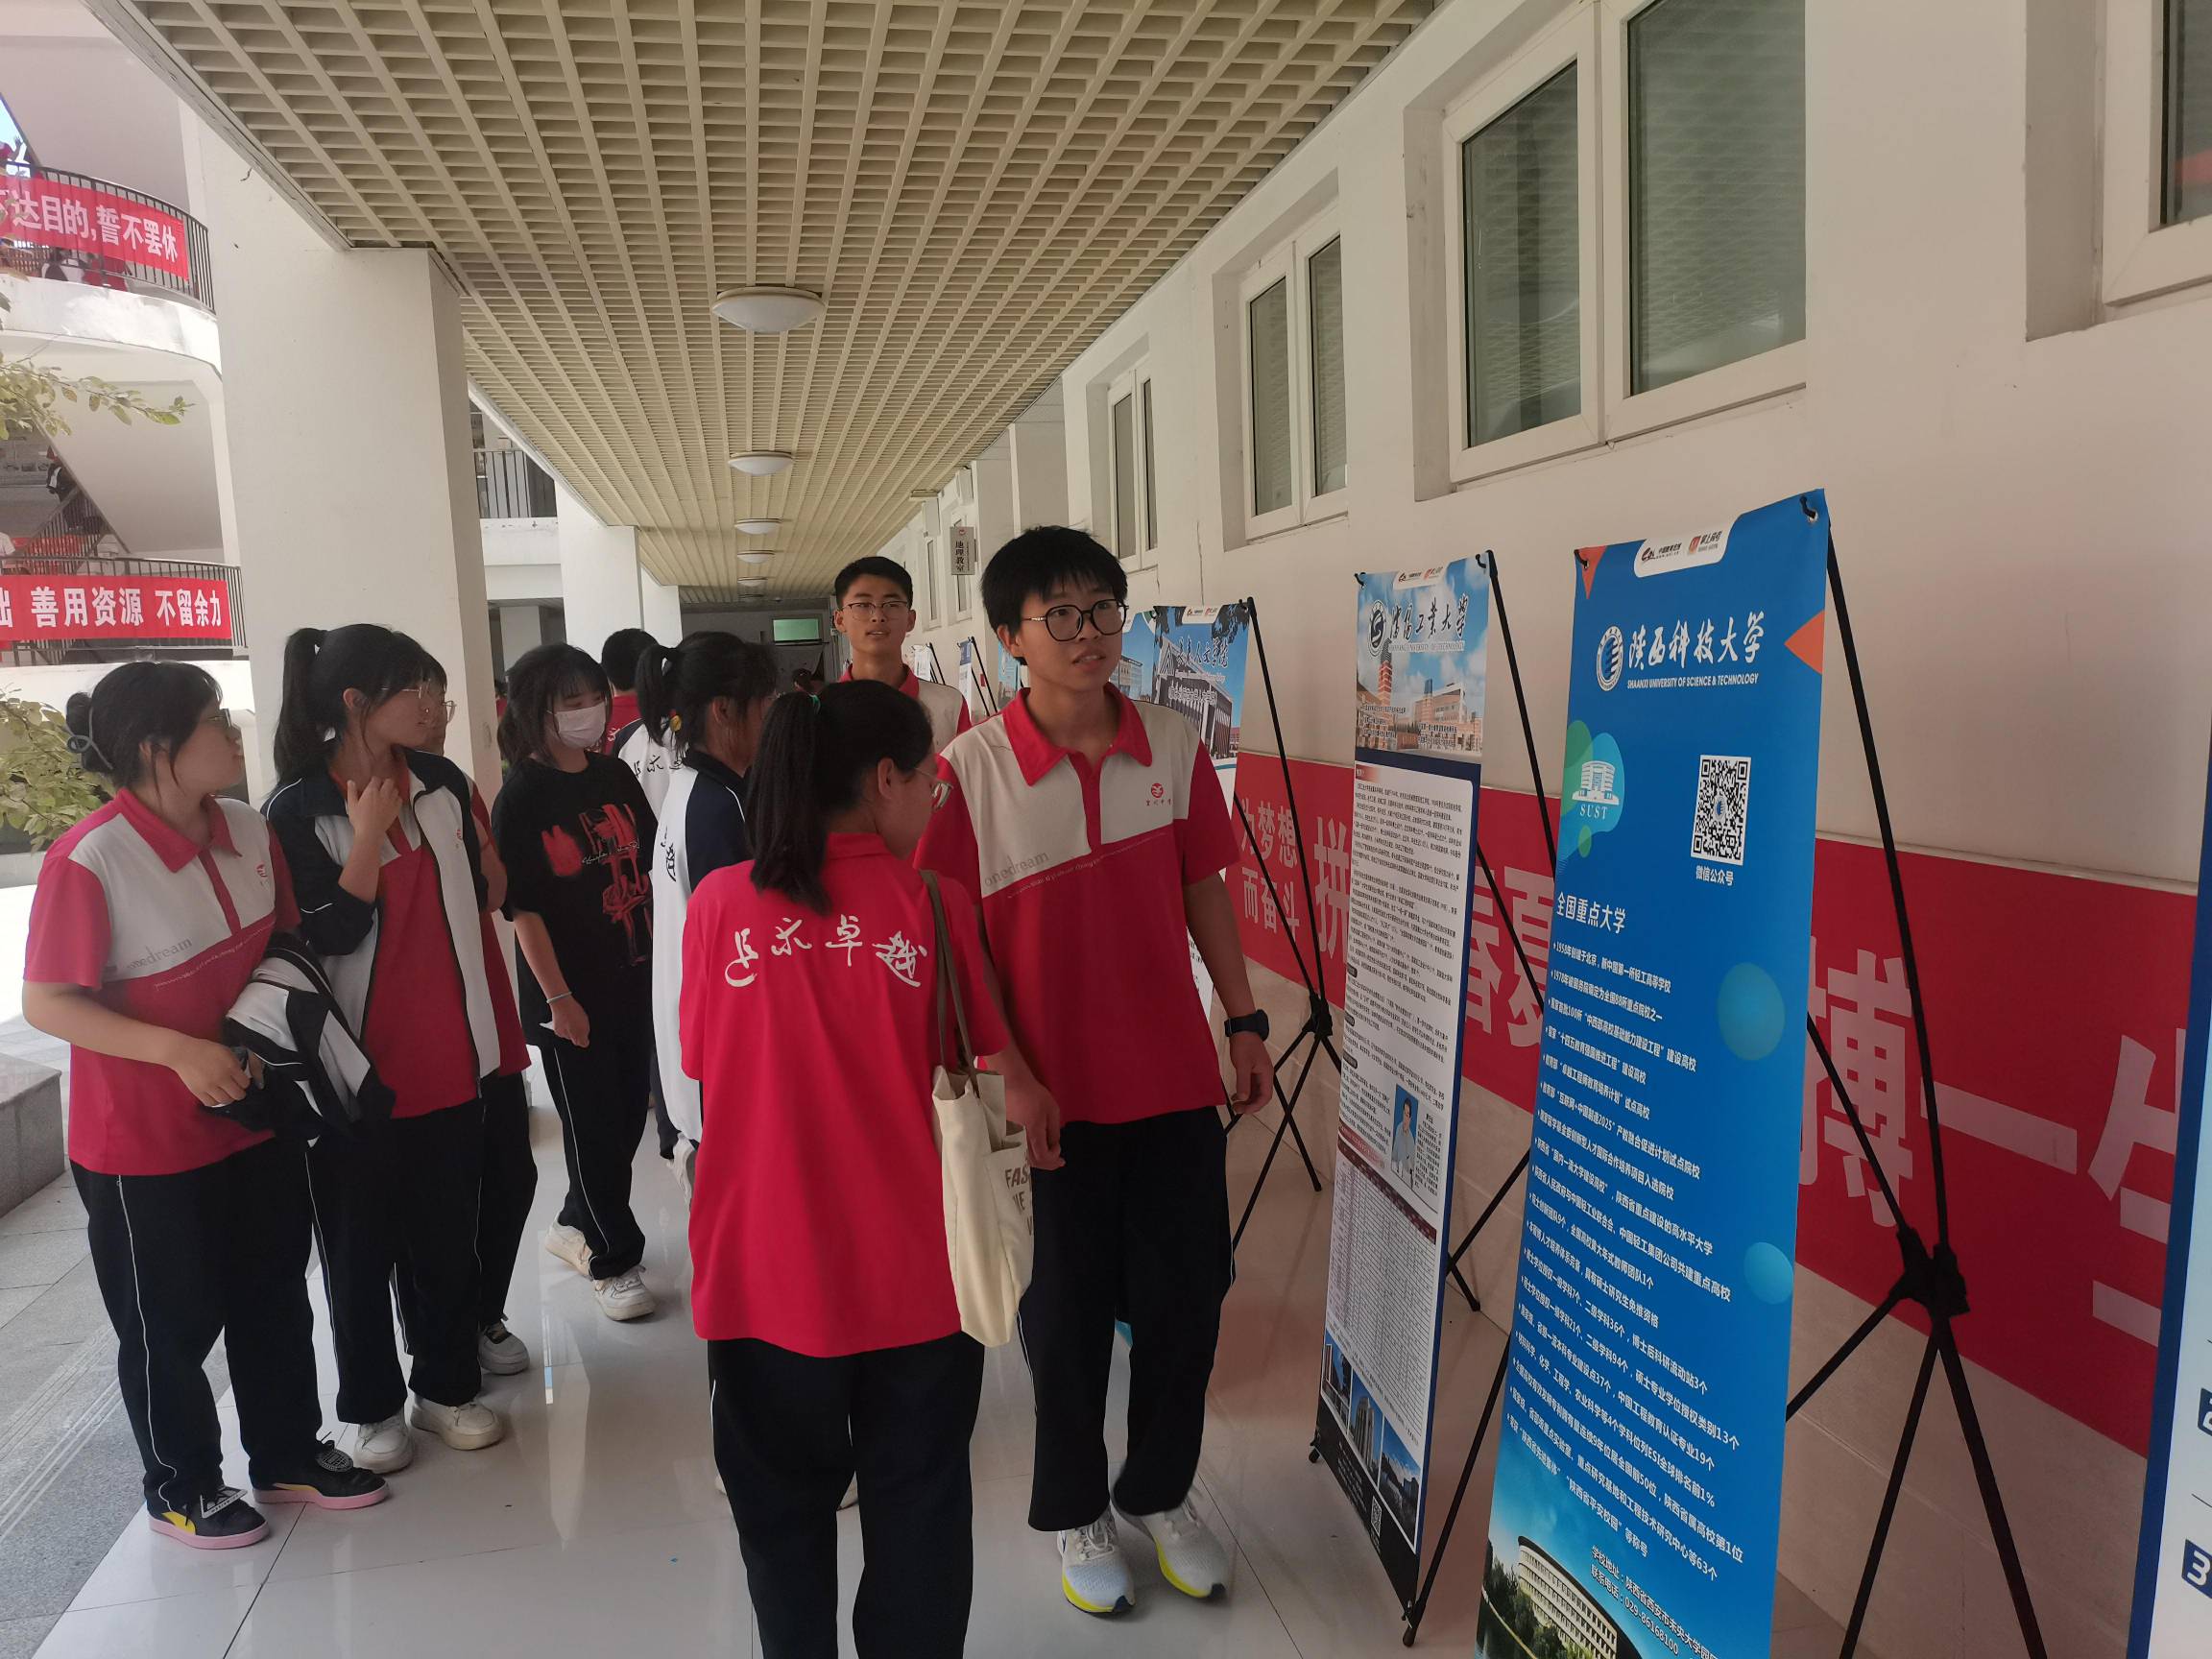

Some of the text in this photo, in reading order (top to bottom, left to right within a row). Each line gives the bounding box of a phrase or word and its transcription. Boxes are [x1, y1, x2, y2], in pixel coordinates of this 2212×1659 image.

[31, 587, 144, 628] 善用资源
[155, 589, 223, 628] 不留余力
[1628, 610, 1765, 670] 陕西科技大学
[1648, 677, 1677, 688] UNIVERSITY
[1677, 677, 1686, 687] OF
[1686, 675, 1712, 687] SCIENCE
[1717, 672, 1759, 686] TECHNOLOGY
[1579, 804, 1608, 821] SUST
[984, 850, 1050, 888] onedream
[1695, 865, 1735, 886] 微信公众号
[1241, 866, 1300, 939] 而奋斗
[1555, 890, 1626, 934] 全国重点大学
